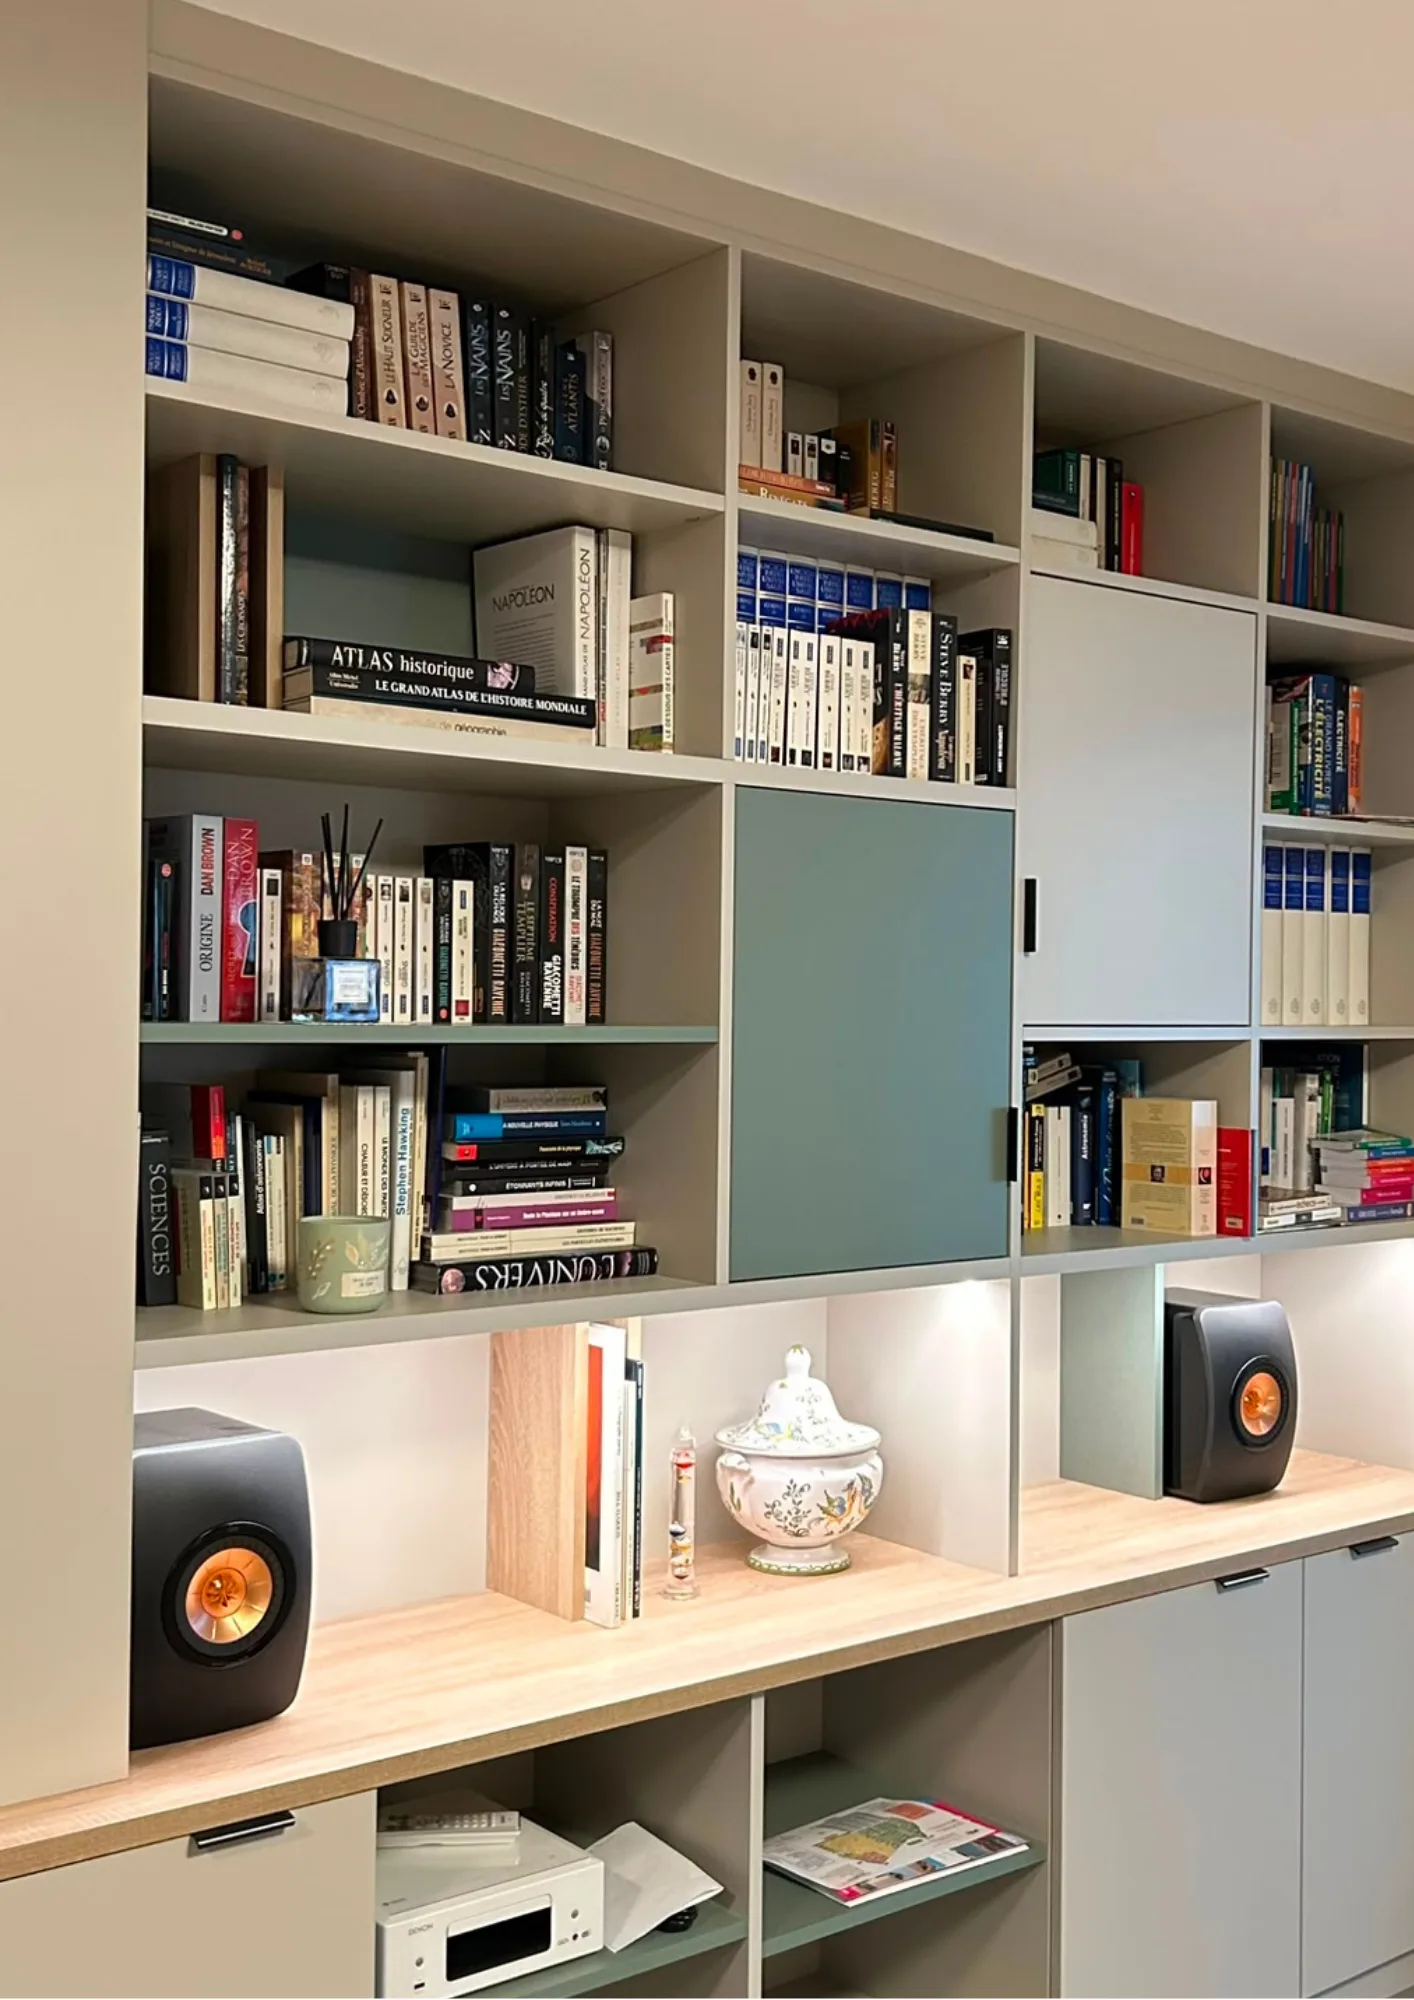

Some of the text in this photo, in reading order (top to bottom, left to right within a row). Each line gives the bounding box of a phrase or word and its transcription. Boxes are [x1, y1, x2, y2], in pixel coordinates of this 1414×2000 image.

[381, 299, 393, 344] SEIGNEUR
[409, 320, 420, 376] LA GUILDE
[417, 311, 428, 371] MAGICIENS
[383, 345, 395, 373] HAUT
[441, 323, 455, 389] LA NOVICE
[470, 324, 488, 380] NAINS
[496, 329, 514, 386] NAINS
[567, 373, 579, 433] ATLANTIS
[492, 583, 555, 612] NAPOLÉON
[578, 548, 591, 640] NAPOLÉON
[331, 645, 475, 682] ATLAS historique
[892, 642, 902, 672] BERRY
[939, 633, 953, 725] STEVE BERRY
[376, 679, 587, 716] LE GRAND ATLAS DE L'HISTOIRE MONDIALE
[1325, 699, 1332, 711] LE
[1314, 699, 1326, 799] L'ÉLECTRICITÉ
[201, 828, 215, 896] DAN BROWN
[227, 841, 239, 881] DAN
[239, 827, 254, 898] BROWN
[548, 877, 557, 943] CONSPIRATION
[571, 885, 581, 920] TRIOMPHE
[571, 921, 580, 935] DES
[199, 913, 213, 972] ORIGINE
[516, 901, 527, 963] TEMPLIER
[526, 901, 536, 962] LE SEPTIÈME
[491, 928, 505, 1016] GIACOMETTI RAVENNE
[543, 961, 552, 1009] RAVENNE
[551, 954, 561, 1016] GIACOMETTI
[589, 933, 603, 1017] GIACOMETTI RAVENNE
[534, 1120, 559, 1128] PHYSIQUE
[1081, 1114, 1089, 1160] Astronomie
[256, 1139, 264, 1215] Atlas d'astronomie
[396, 1107, 410, 1216] Stephen Hawking
[149, 1163, 169, 1276] SCIENCES
[361, 1187, 369, 1216] DÉSORD
[475, 1255, 615, 1291] L'UNIVERS
[408, 1923, 433, 1936] DENON
